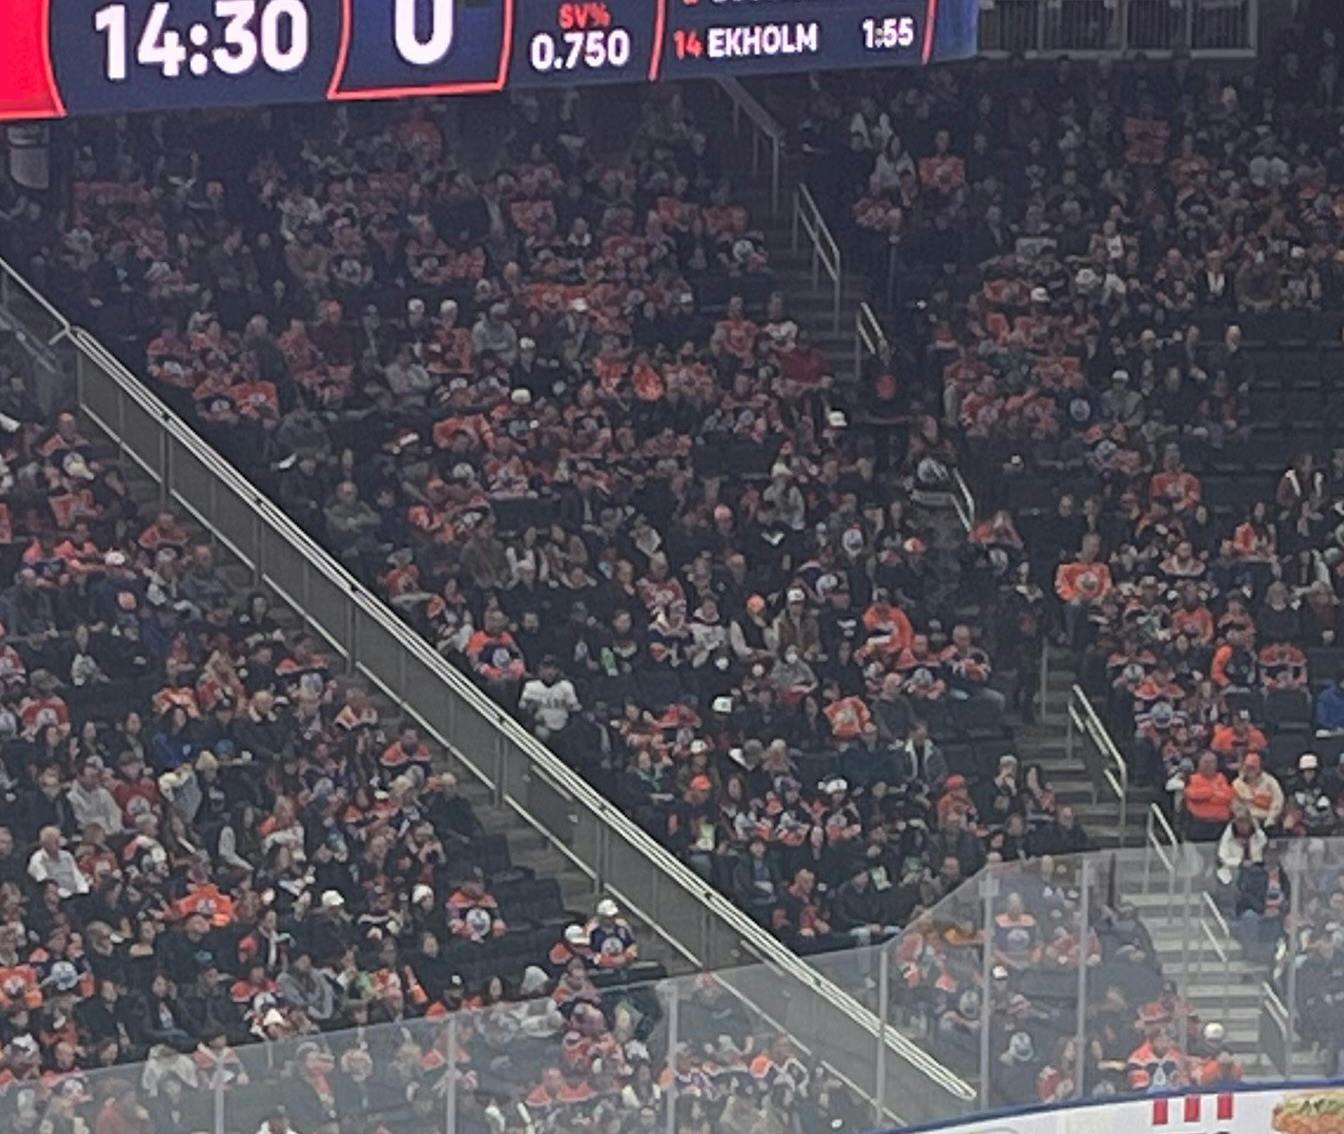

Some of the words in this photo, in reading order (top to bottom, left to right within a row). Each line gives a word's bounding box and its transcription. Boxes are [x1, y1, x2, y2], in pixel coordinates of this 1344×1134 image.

[558, 1, 611, 29] SV%
[95, 0, 309, 80] 14:30
[531, 30, 630, 71] 0.750
[674, 30, 703, 58] 14
[708, 23, 818, 57] EKHOLM
[862, 17, 914, 48] 1:55
